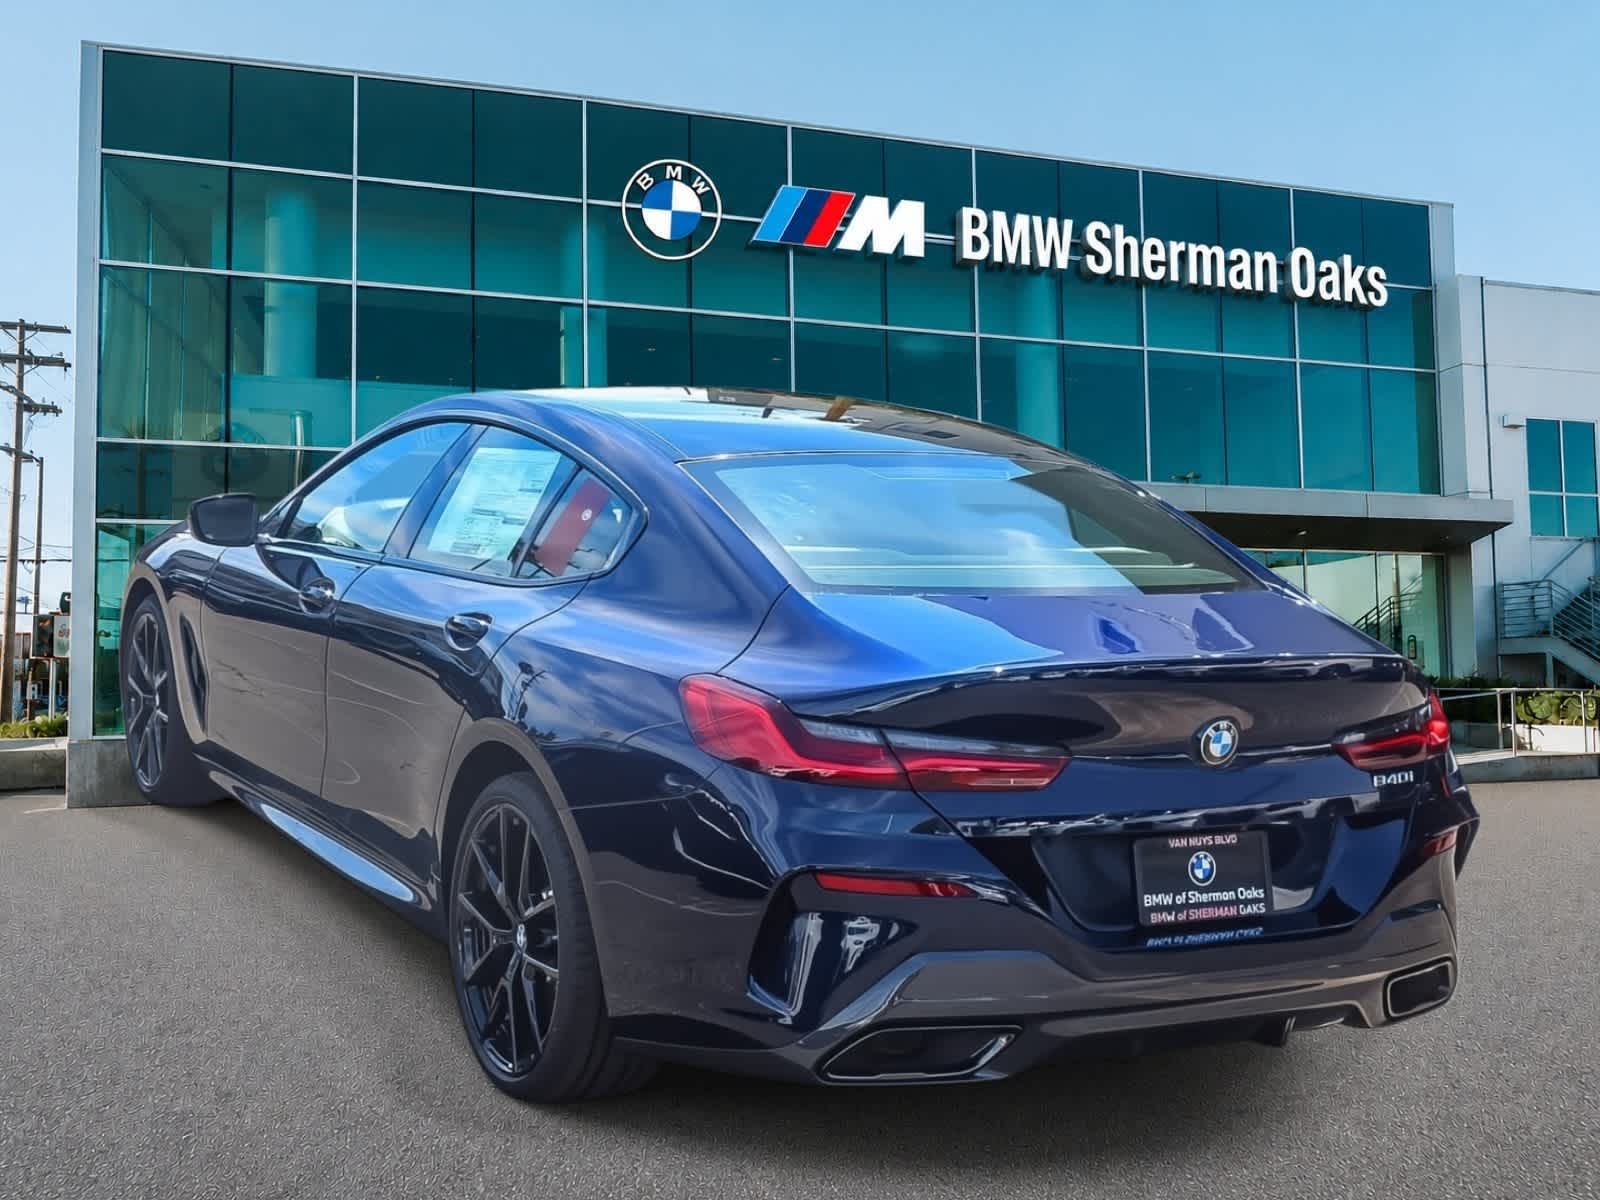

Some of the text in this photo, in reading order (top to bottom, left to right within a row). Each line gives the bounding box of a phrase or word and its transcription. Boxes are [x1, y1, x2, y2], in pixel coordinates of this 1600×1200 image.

[636, 165, 710, 195] BMW
[837, 194, 925, 257] M
[959, 206, 1388, 308] BMW Sherman Oaks
[1168, 834, 1238, 848] VAN NUYS BLVD
[1143, 886, 1265, 907] BMW of Sherman Oaks
[1150, 912, 1175, 924] BMW
[1177, 910, 1187, 921] of
[1189, 905, 1237, 920] SHERMAN
